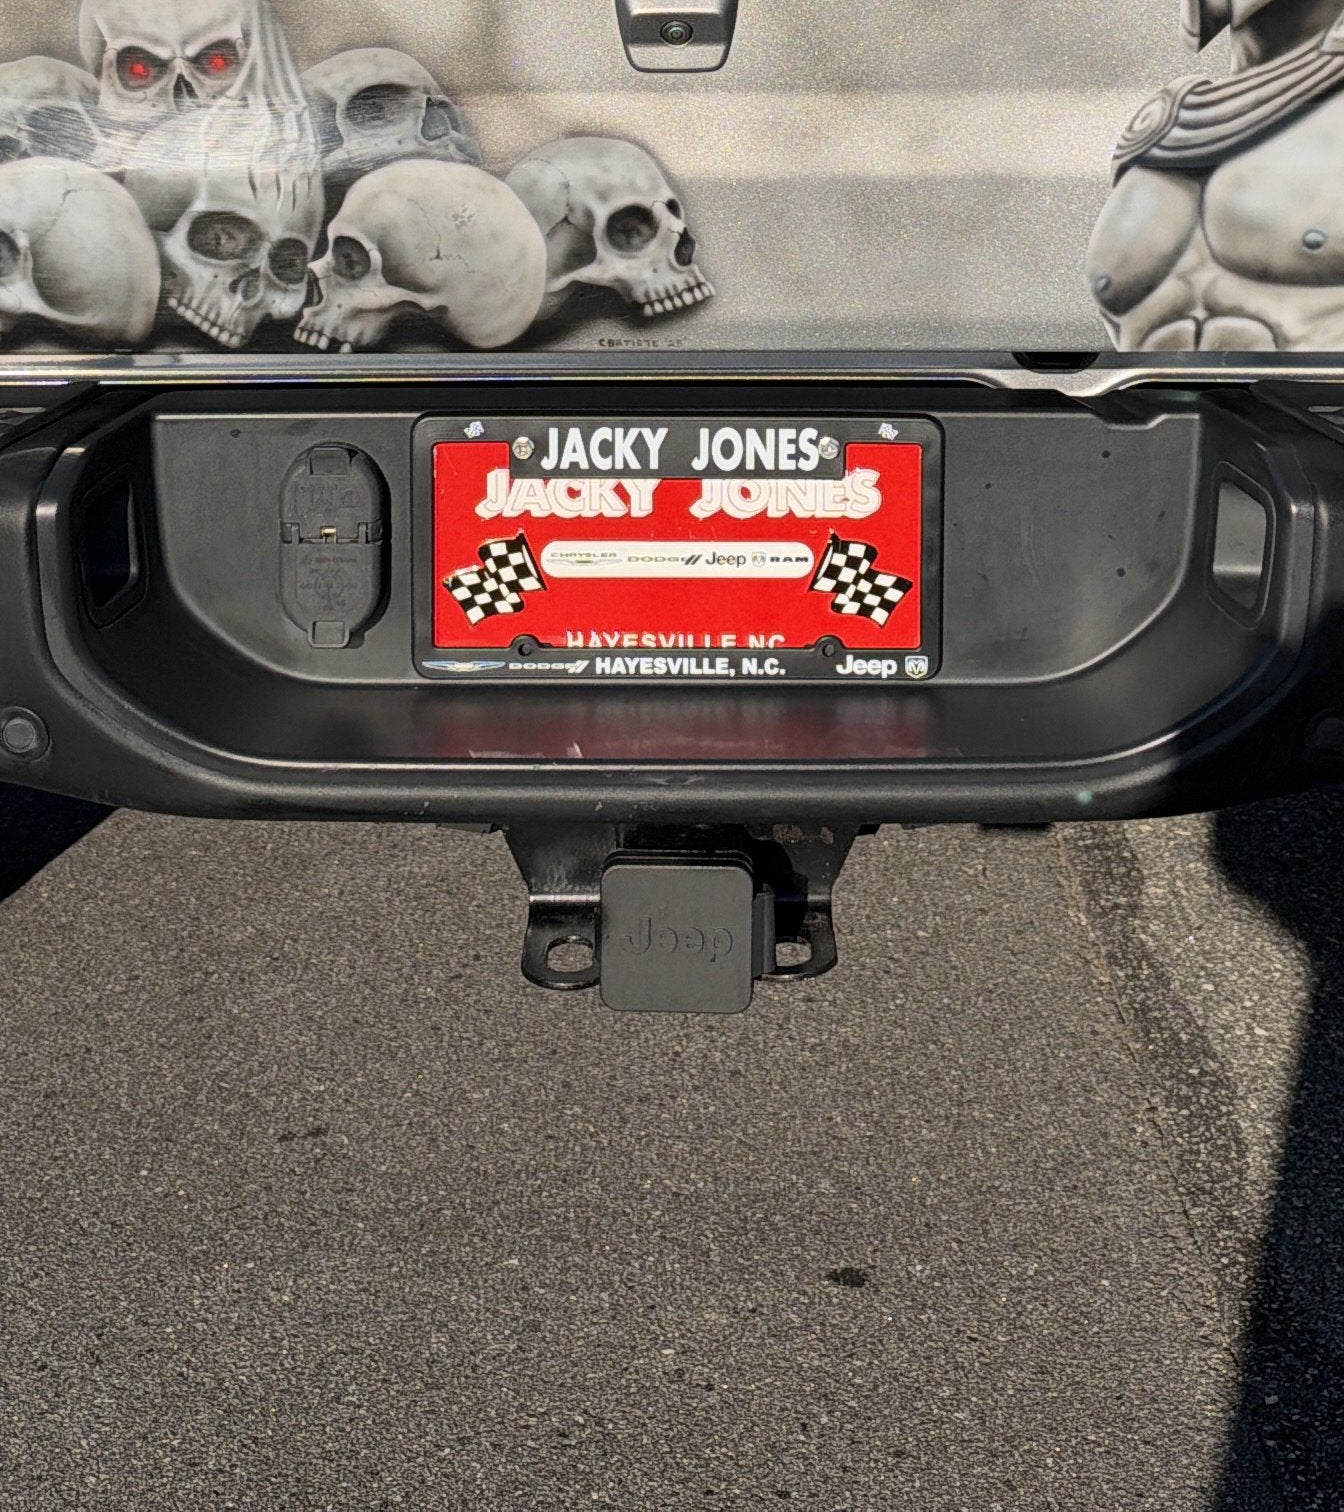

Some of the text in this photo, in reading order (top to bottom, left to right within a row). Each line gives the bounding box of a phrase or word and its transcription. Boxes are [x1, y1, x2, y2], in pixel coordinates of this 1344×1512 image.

[540, 426, 820, 472] JACKY JONES
[474, 467, 883, 520] JACKY JONES
[705, 552, 747, 568] Jeep
[595, 656, 736, 678] HAYESVILLE,
[741, 657, 786, 676] N.C.
[836, 654, 898, 679] Jeep
[619, 915, 734, 963] Jeep
